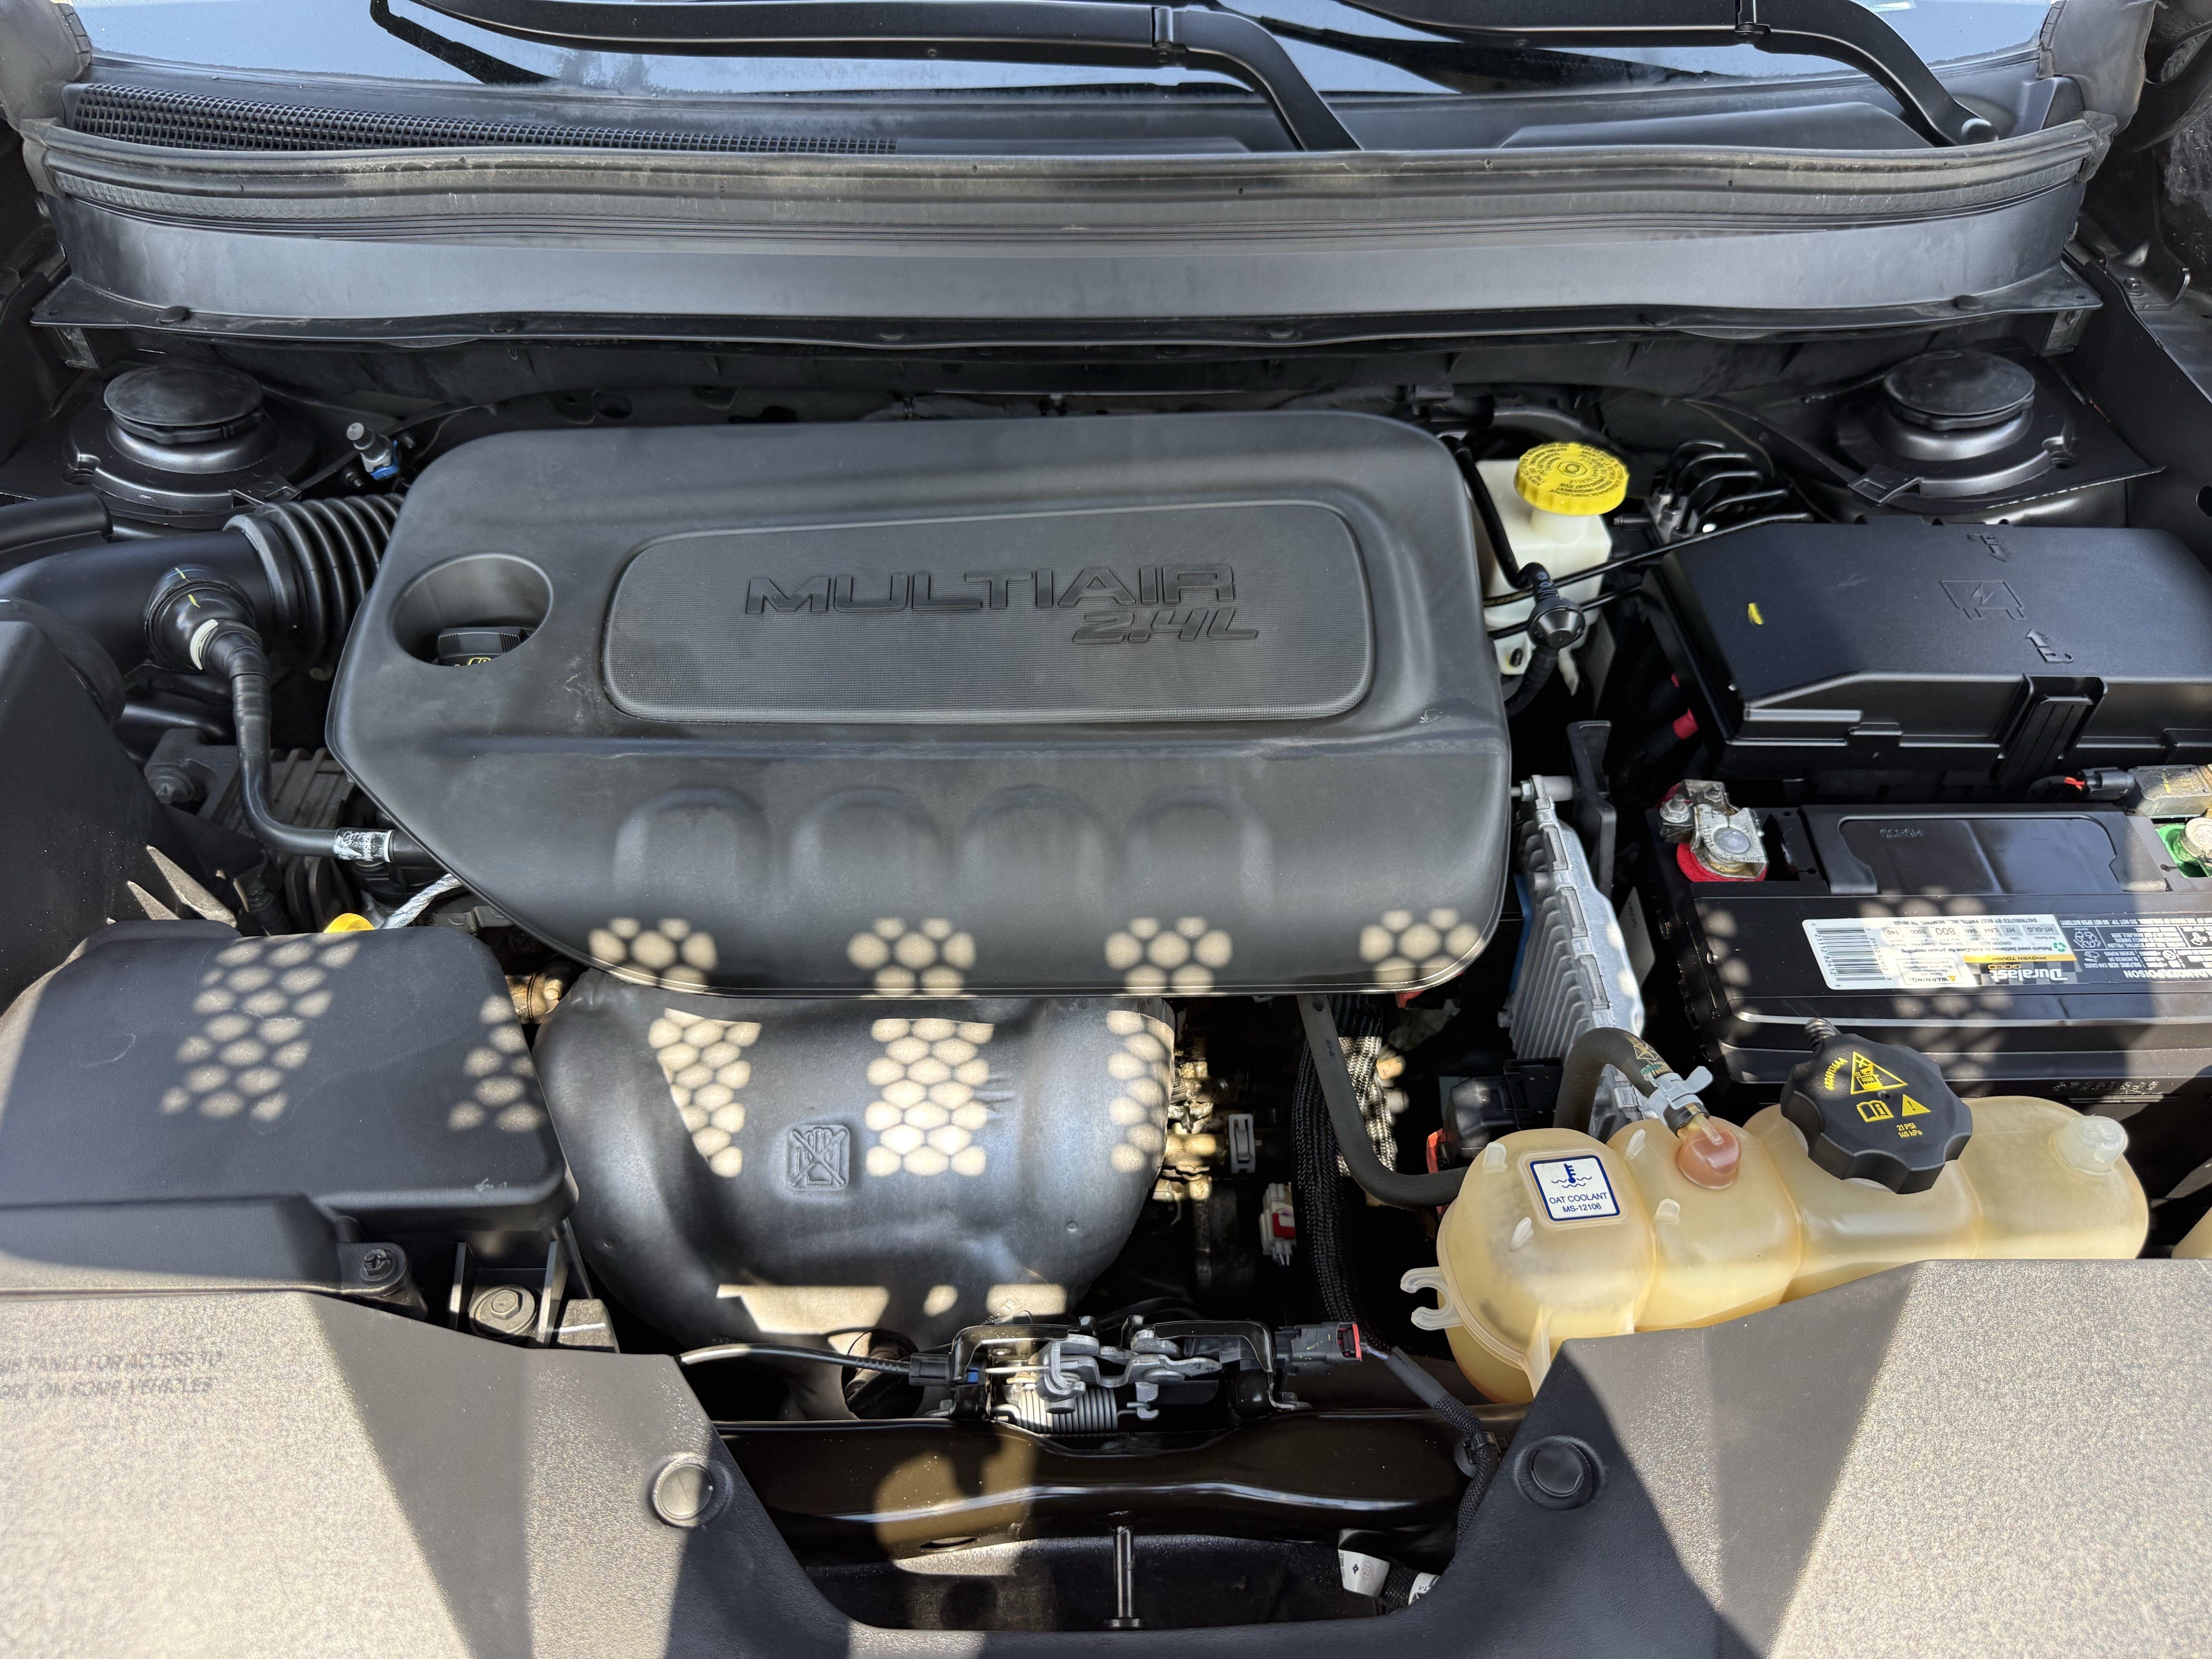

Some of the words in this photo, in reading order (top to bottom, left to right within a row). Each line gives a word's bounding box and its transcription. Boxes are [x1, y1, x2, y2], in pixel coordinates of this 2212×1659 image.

[745, 565, 1236, 615] MULTIAIR
[1072, 607, 1261, 643] 2.4L
[1815, 934, 1827, 953] 21112
[1989, 969, 2068, 982] Duralast
[1567, 1192, 1607, 1202] COOLANT
[1562, 1203, 1602, 1212] MS-12106
